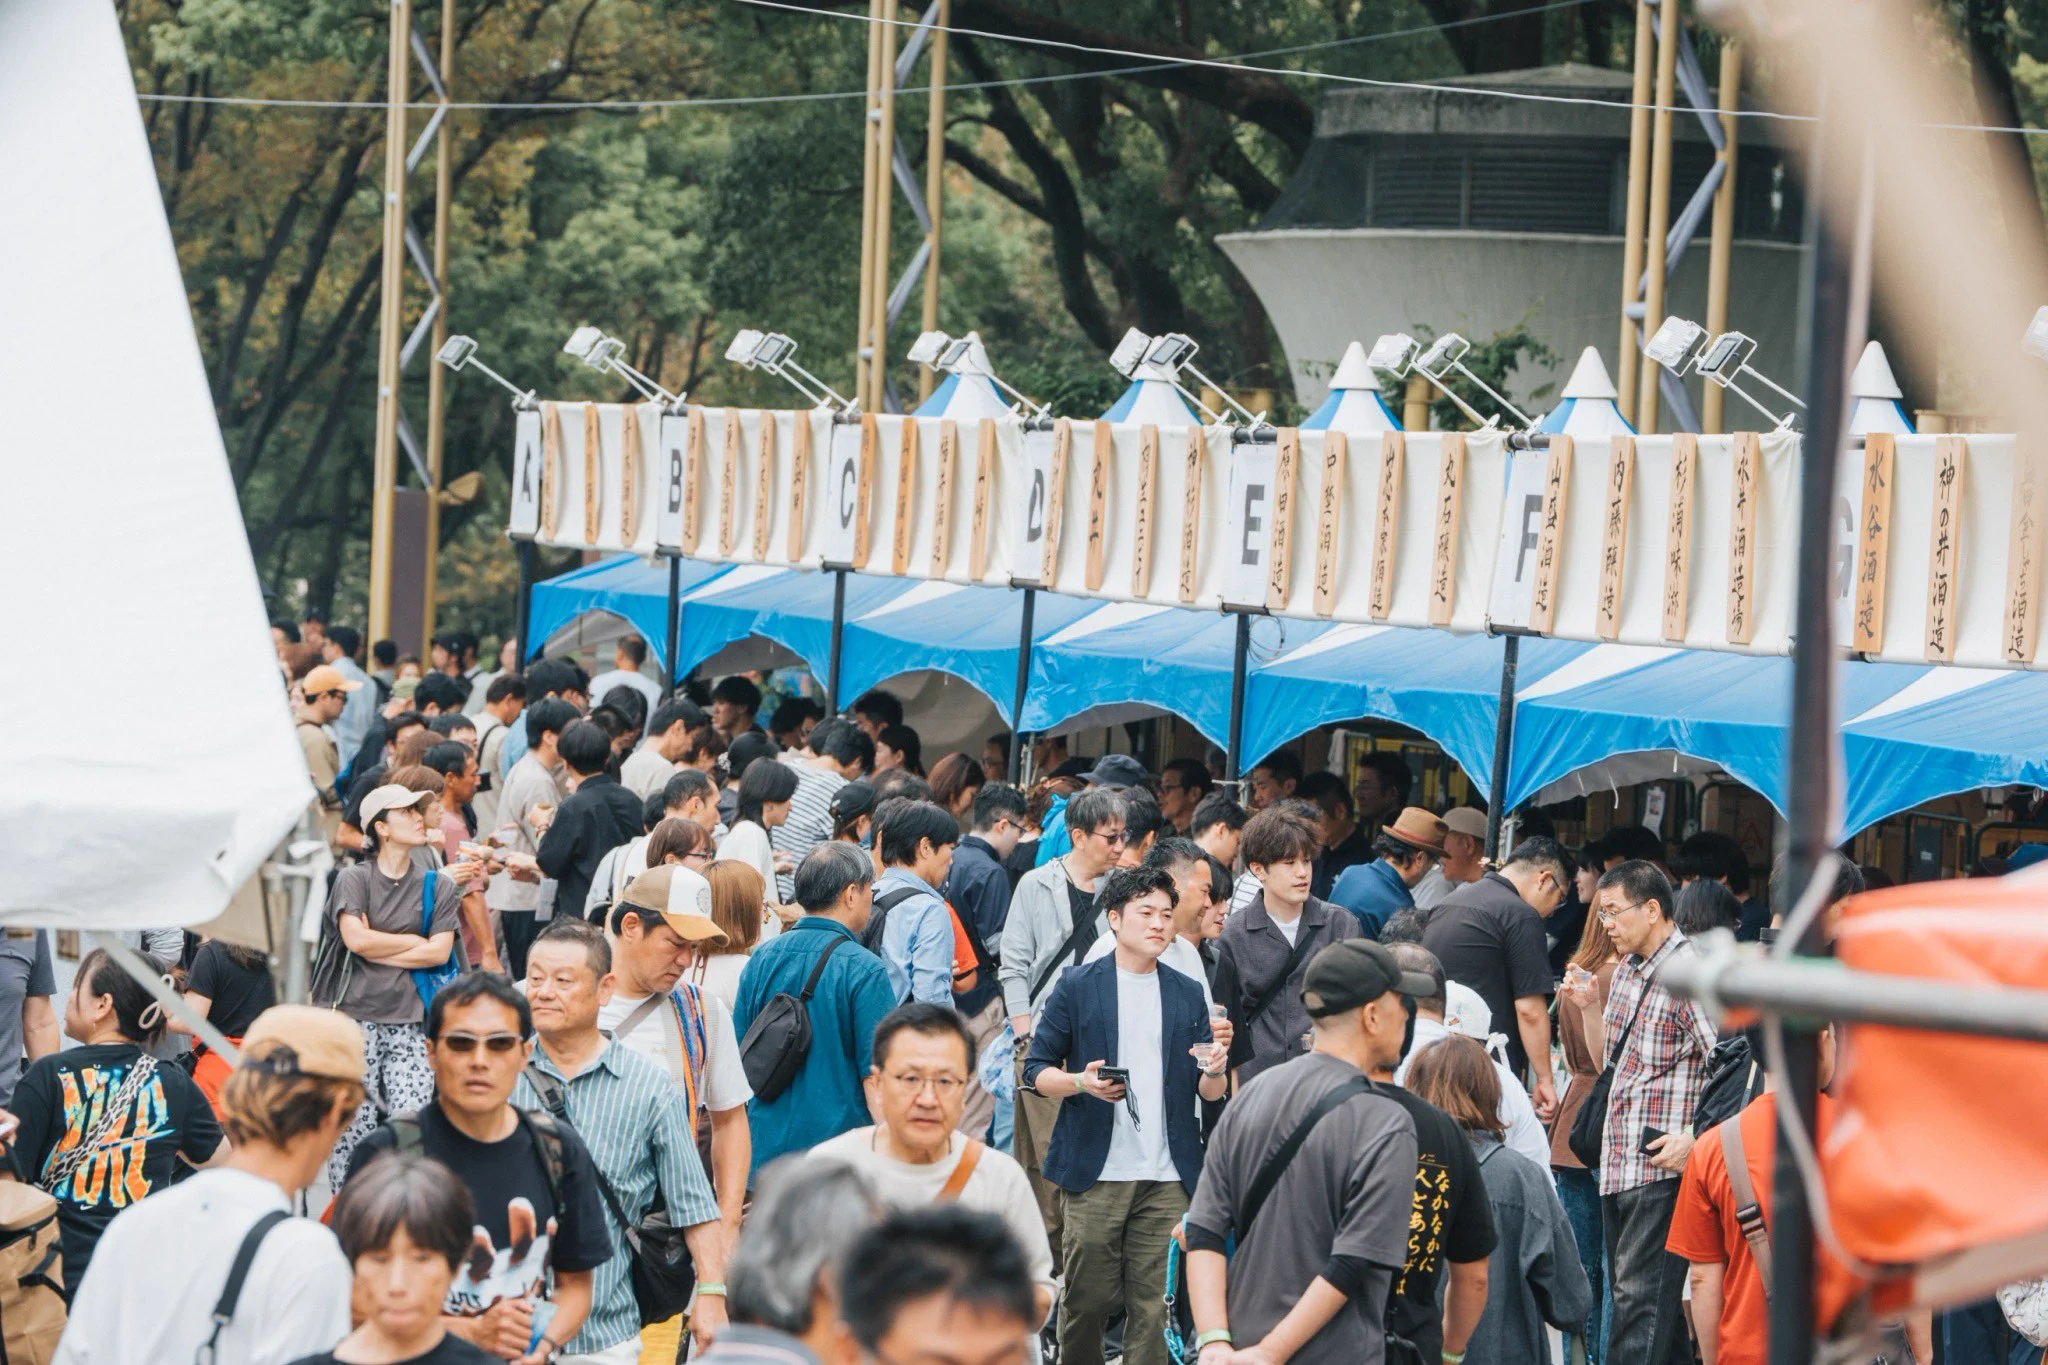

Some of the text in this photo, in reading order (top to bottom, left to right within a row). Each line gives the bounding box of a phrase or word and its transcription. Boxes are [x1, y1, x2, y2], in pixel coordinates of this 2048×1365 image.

[523, 442, 531, 503] A
[669, 449, 683, 514] B
[841, 457, 856, 529] C
[1027, 468, 1044, 542] D
[1241, 484, 1265, 565] E
[1271, 445, 1291, 596] 原田酒造
[1515, 494, 1543, 582] F
[1858, 447, 1886, 639] 水谷酒造
[1930, 453, 1957, 654] 神の井酒造
[1419, 1169, 1451, 1274] なかなかに
